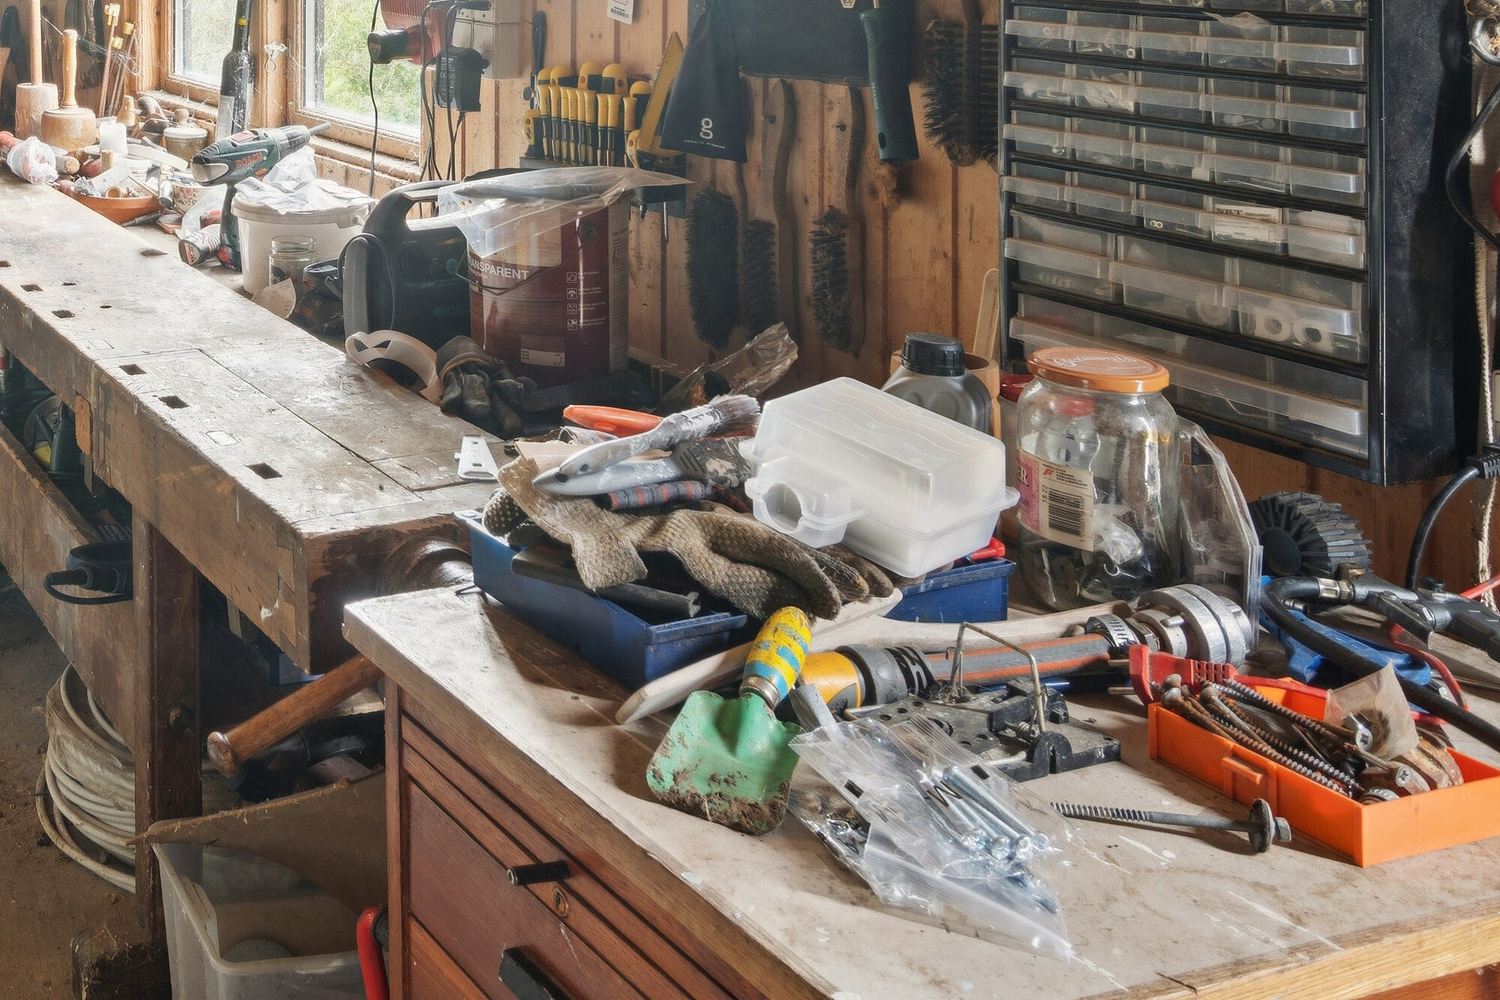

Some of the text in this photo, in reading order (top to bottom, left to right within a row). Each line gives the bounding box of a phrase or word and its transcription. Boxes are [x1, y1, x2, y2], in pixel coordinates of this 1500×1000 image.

[235, 152, 263, 169] BOSCH
[1216, 208, 1243, 216] NKT
[468, 256, 530, 281] ANSPARENT
